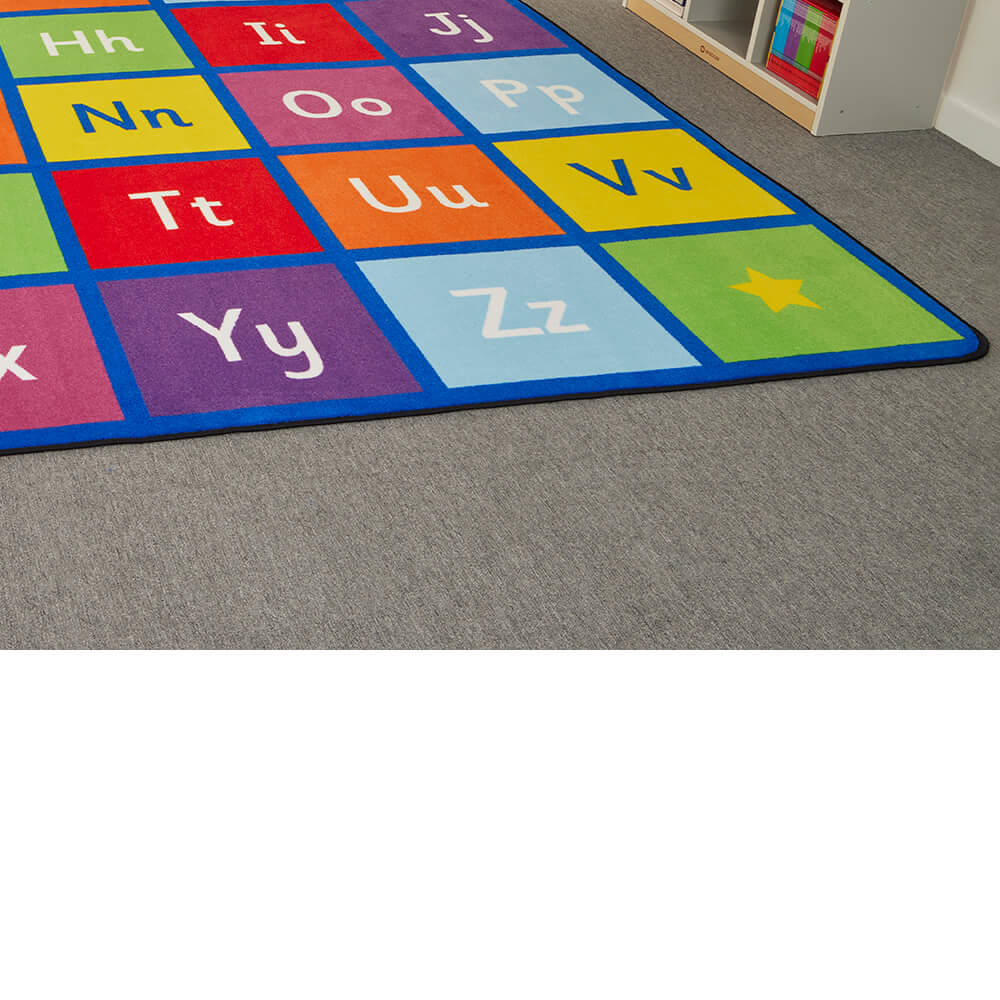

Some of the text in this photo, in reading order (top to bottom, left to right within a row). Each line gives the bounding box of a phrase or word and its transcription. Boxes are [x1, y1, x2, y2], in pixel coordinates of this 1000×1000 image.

[40, 30, 142, 56] Hh
[244, 22, 305, 45] Ii
[424, 12, 493, 42] Jj
[283, 90, 392, 118] Oo
[480, 80, 584, 114] Pp
[72, 101, 192, 133] Nn
[349, 176, 488, 213] Uu
[568, 159, 692, 196] Vv
[128, 190, 233, 230] Tt
[449, 287, 590, 338] Zz
[178, 308, 323, 379] Yy
